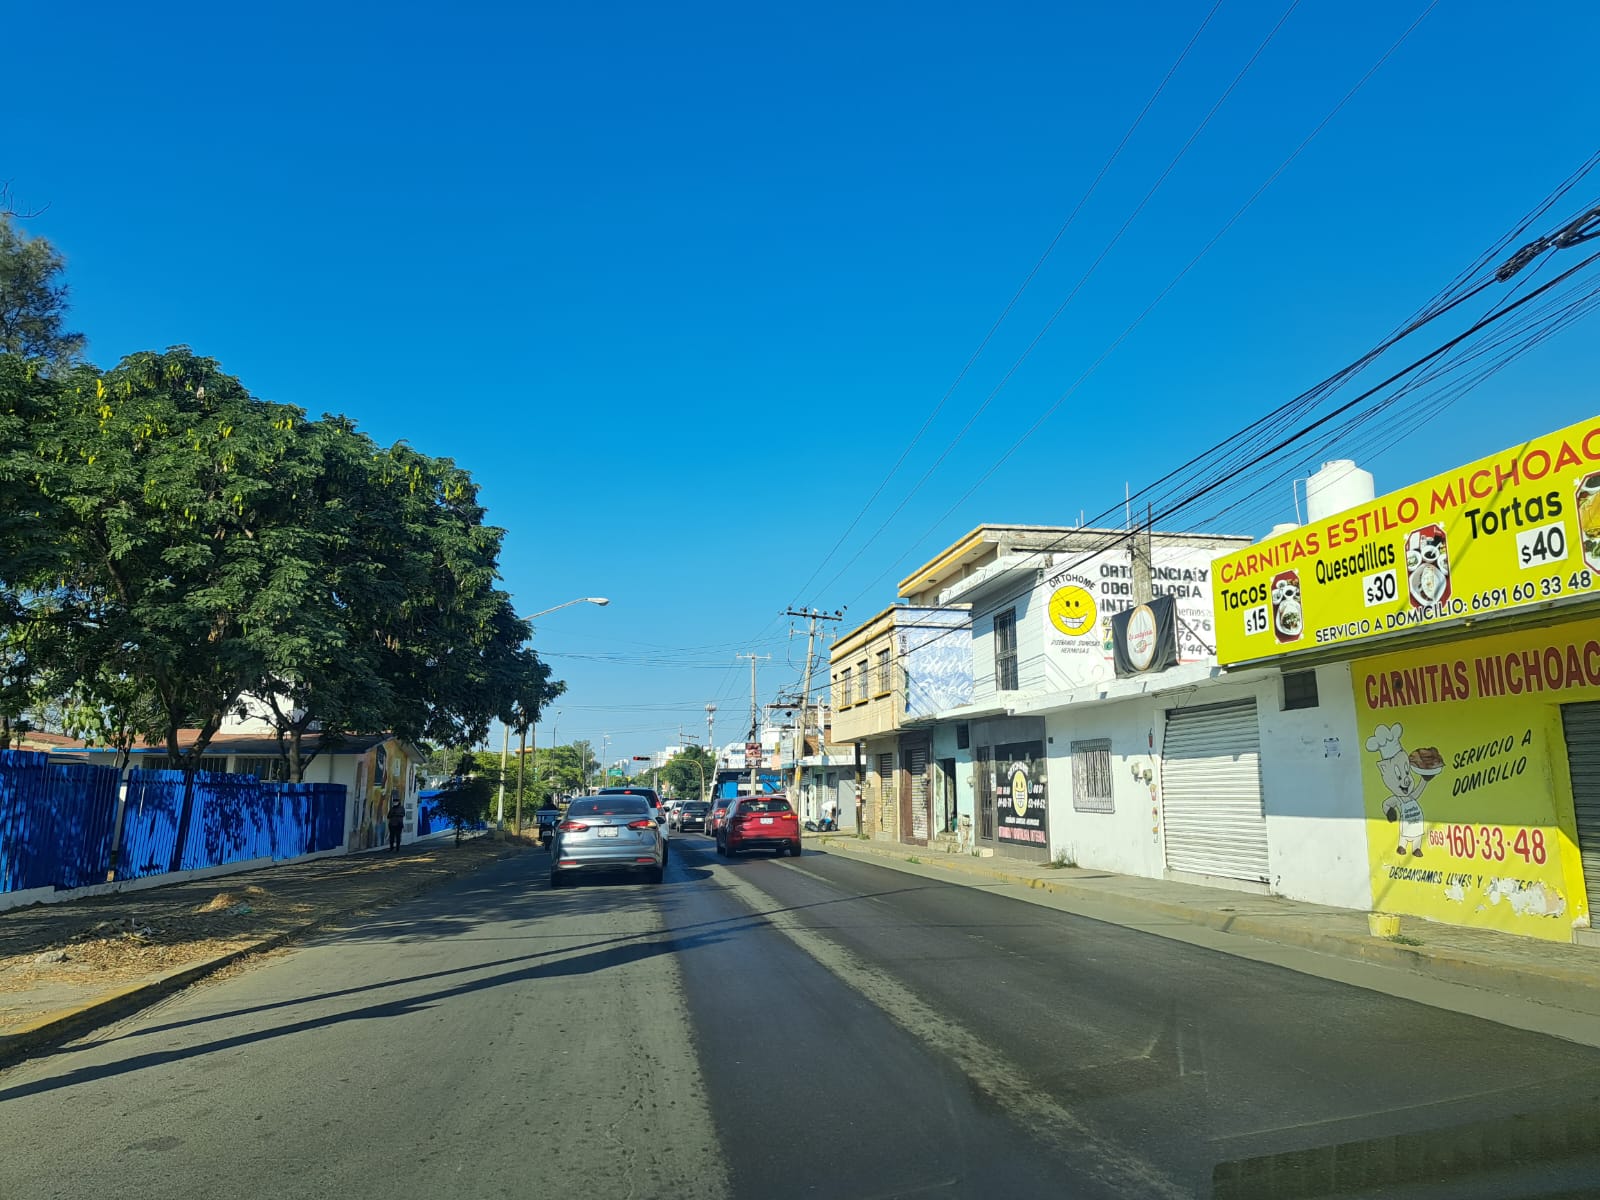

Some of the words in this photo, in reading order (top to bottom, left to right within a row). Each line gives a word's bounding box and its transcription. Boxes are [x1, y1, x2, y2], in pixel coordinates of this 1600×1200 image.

[1220, 531, 1320, 584] CARNITAS
[1327, 496, 1420, 549] ESTILO
[1430, 428, 1600, 515] MICHOAC
[1465, 491, 1563, 540] Tortas
[1315, 541, 1396, 585] Quesadillas
[1521, 529, 1565, 565] $40
[1049, 574, 1096, 590] ORTOHOME
[1100, 563, 1192, 582] ORTONCIA
[1101, 582, 1202, 598] ODOOLOGIA
[1221, 583, 1268, 612] Tacos
[1366, 575, 1397, 603] $30
[1246, 607, 1267, 633] $15
[1315, 619, 1371, 643] SERVICIO
[1374, 617, 1383, 631] A
[1386, 598, 1468, 633] DOMICILIO:
[1472, 588, 1508, 610] 6691
[1512, 582, 1535, 601] 60
[1540, 576, 1562, 596] 33
[1568, 570, 1592, 590] 48
[1365, 660, 1470, 709] CARNITAS
[1475, 640, 1600, 698] MICHOAC
[1453, 735, 1514, 770] SERVICIO
[1521, 729, 1532, 747] A
[1452, 756, 1527, 797] DOMICILIO
[1429, 830, 1445, 846] 669
[1477, 875, 1483, 888] Y
